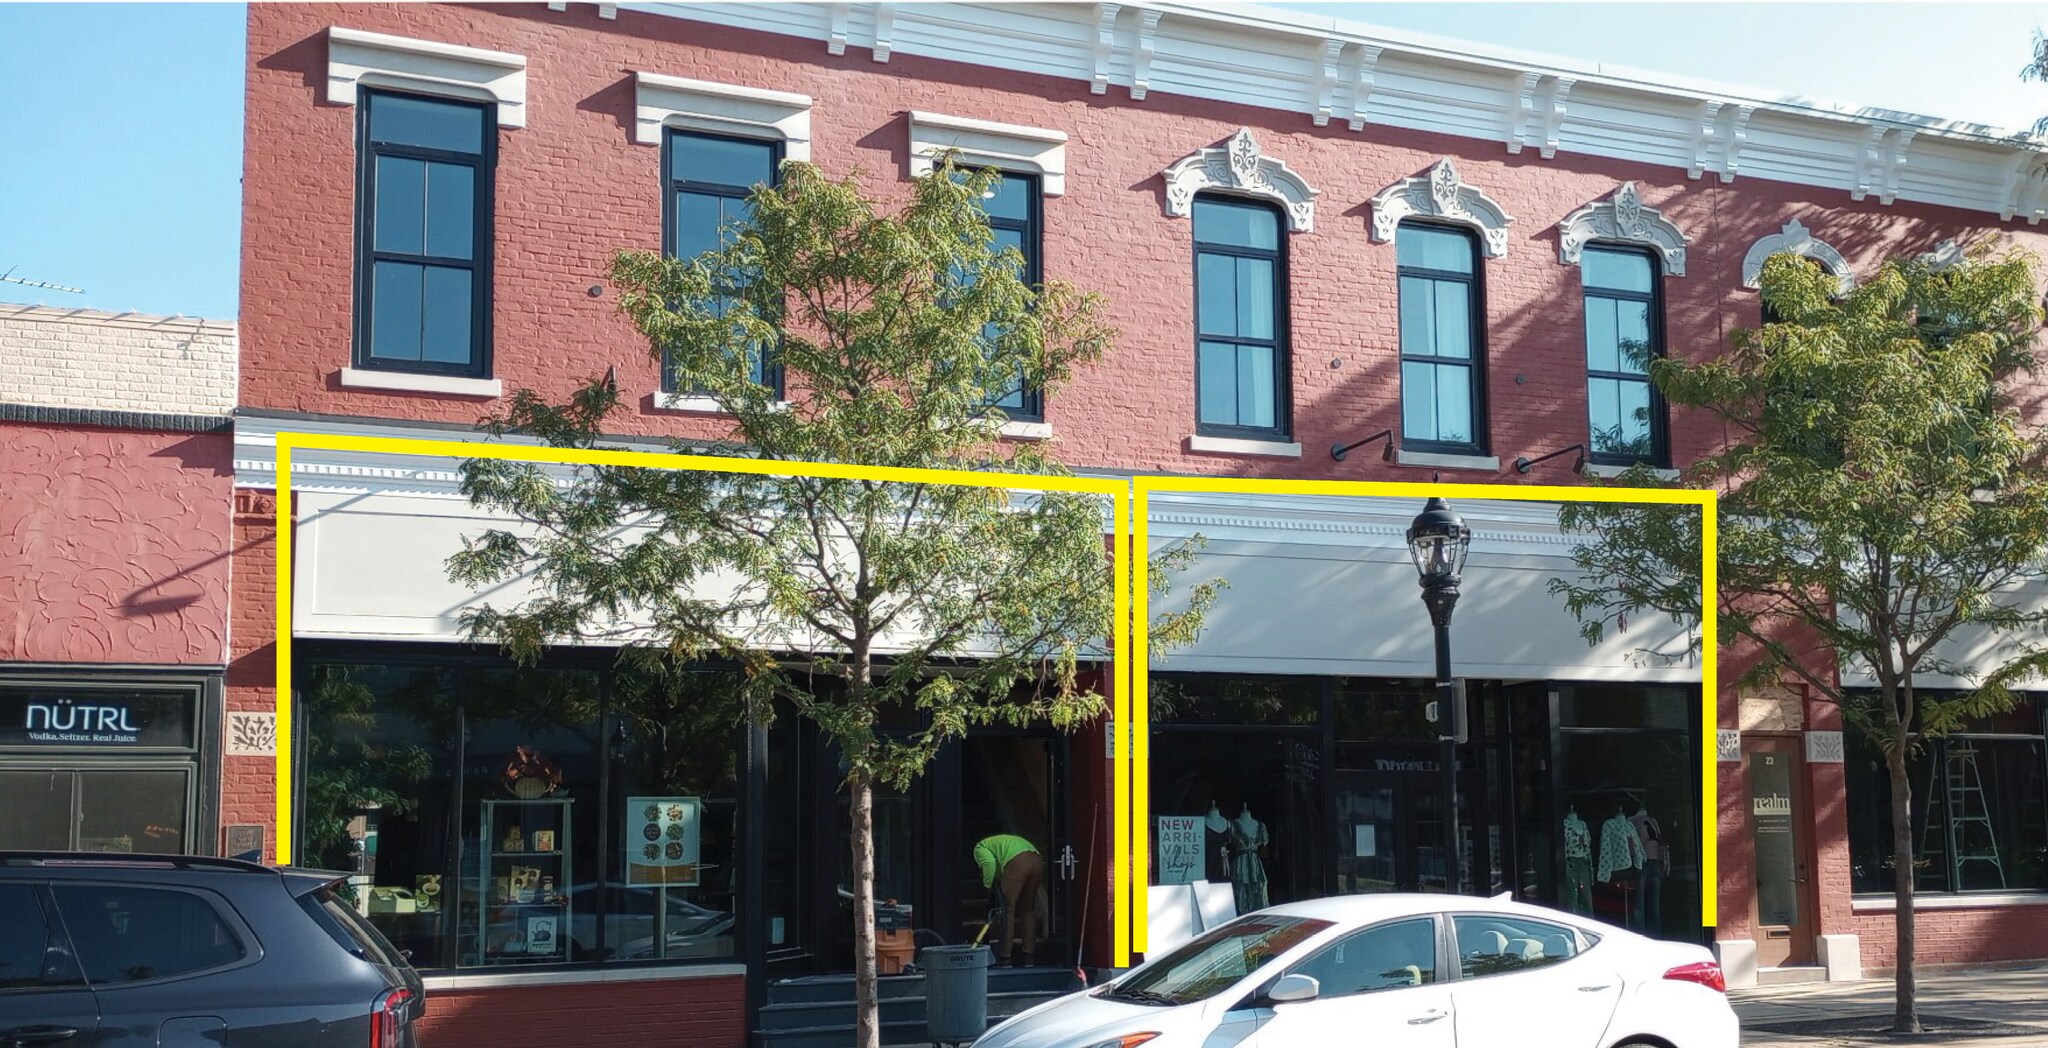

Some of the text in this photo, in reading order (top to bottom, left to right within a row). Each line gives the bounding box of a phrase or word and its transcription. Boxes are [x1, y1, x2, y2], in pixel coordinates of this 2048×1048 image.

[93, 734, 112, 742] Real
[1765, 756, 1774, 765] 23
[1753, 792, 1790, 809] realm
[1161, 819, 1194, 830] NEW
[1162, 832, 1202, 842] ARRI-
[1162, 844, 1200, 855] VALS
